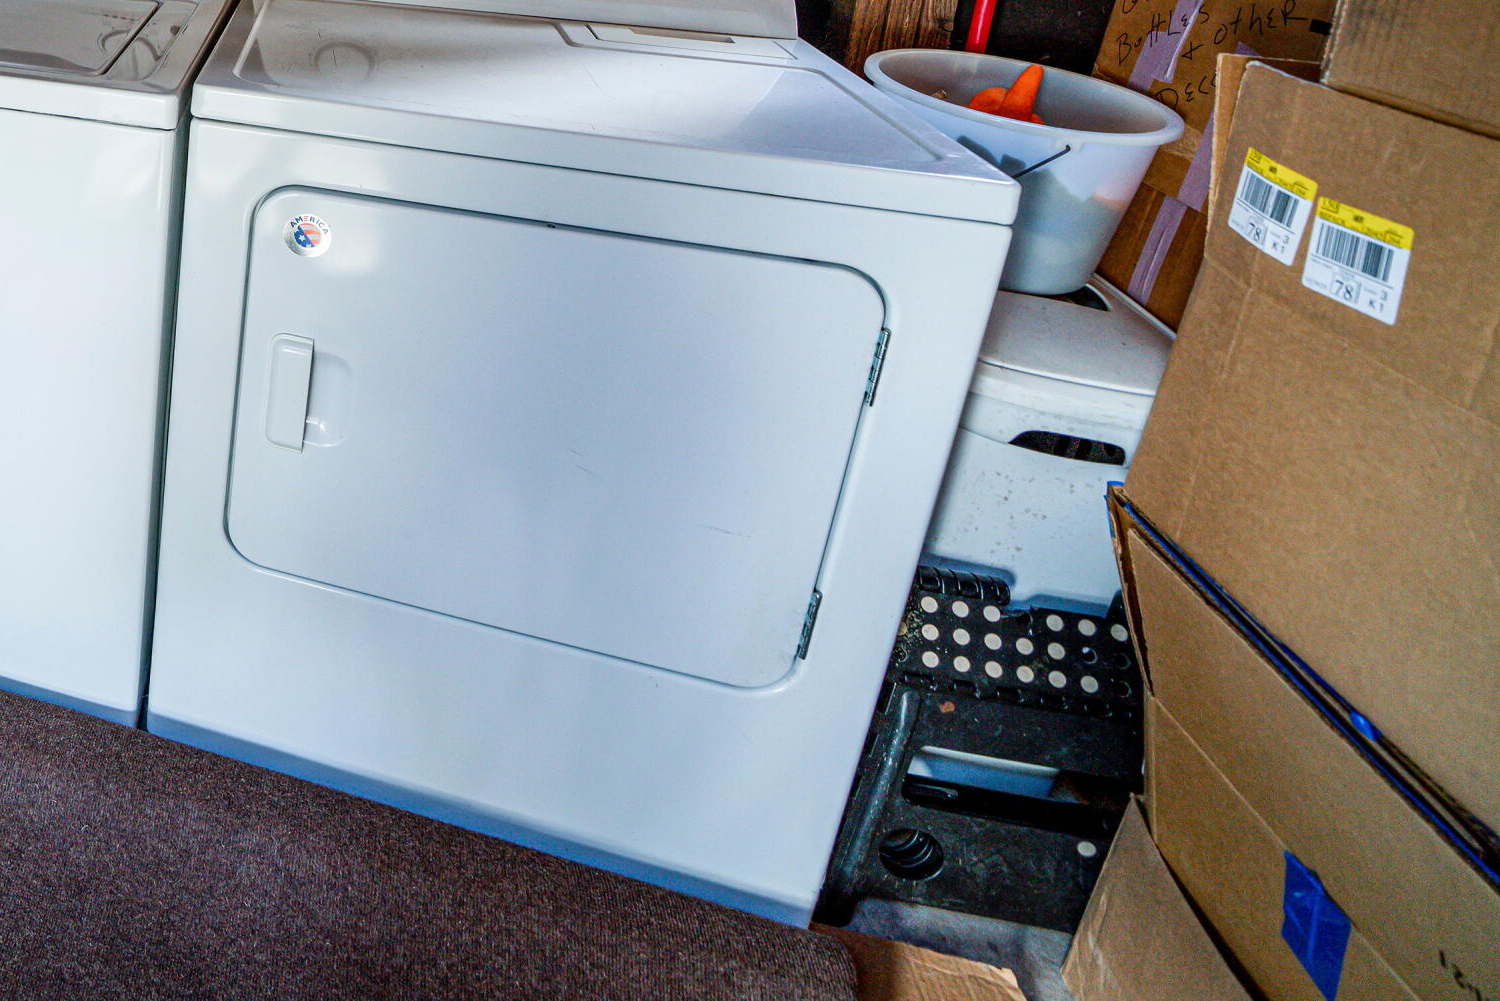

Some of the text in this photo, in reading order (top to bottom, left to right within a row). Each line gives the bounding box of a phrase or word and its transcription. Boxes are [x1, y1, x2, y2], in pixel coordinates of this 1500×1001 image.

[290, 215, 329, 236] AMERICA
[1249, 221, 1263, 242] 78
[1335, 279, 1355, 301] 78
